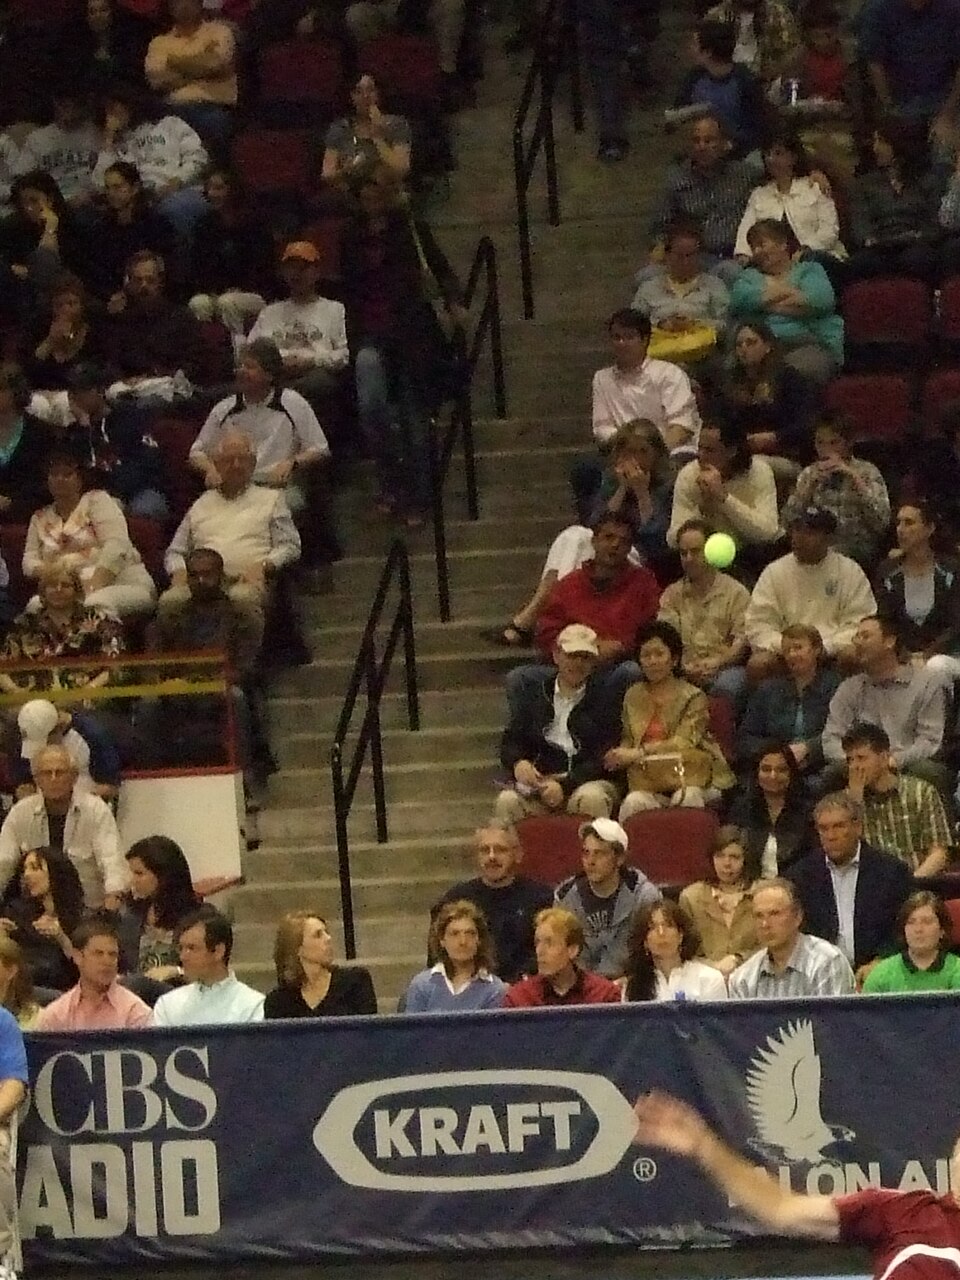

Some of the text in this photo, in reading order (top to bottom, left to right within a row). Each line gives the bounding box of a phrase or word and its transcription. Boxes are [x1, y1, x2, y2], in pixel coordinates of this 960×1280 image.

[35, 1045, 218, 1136] CBS
[373, 1101, 581, 1159] KRAFT
[19, 1139, 221, 1240] ADIO
